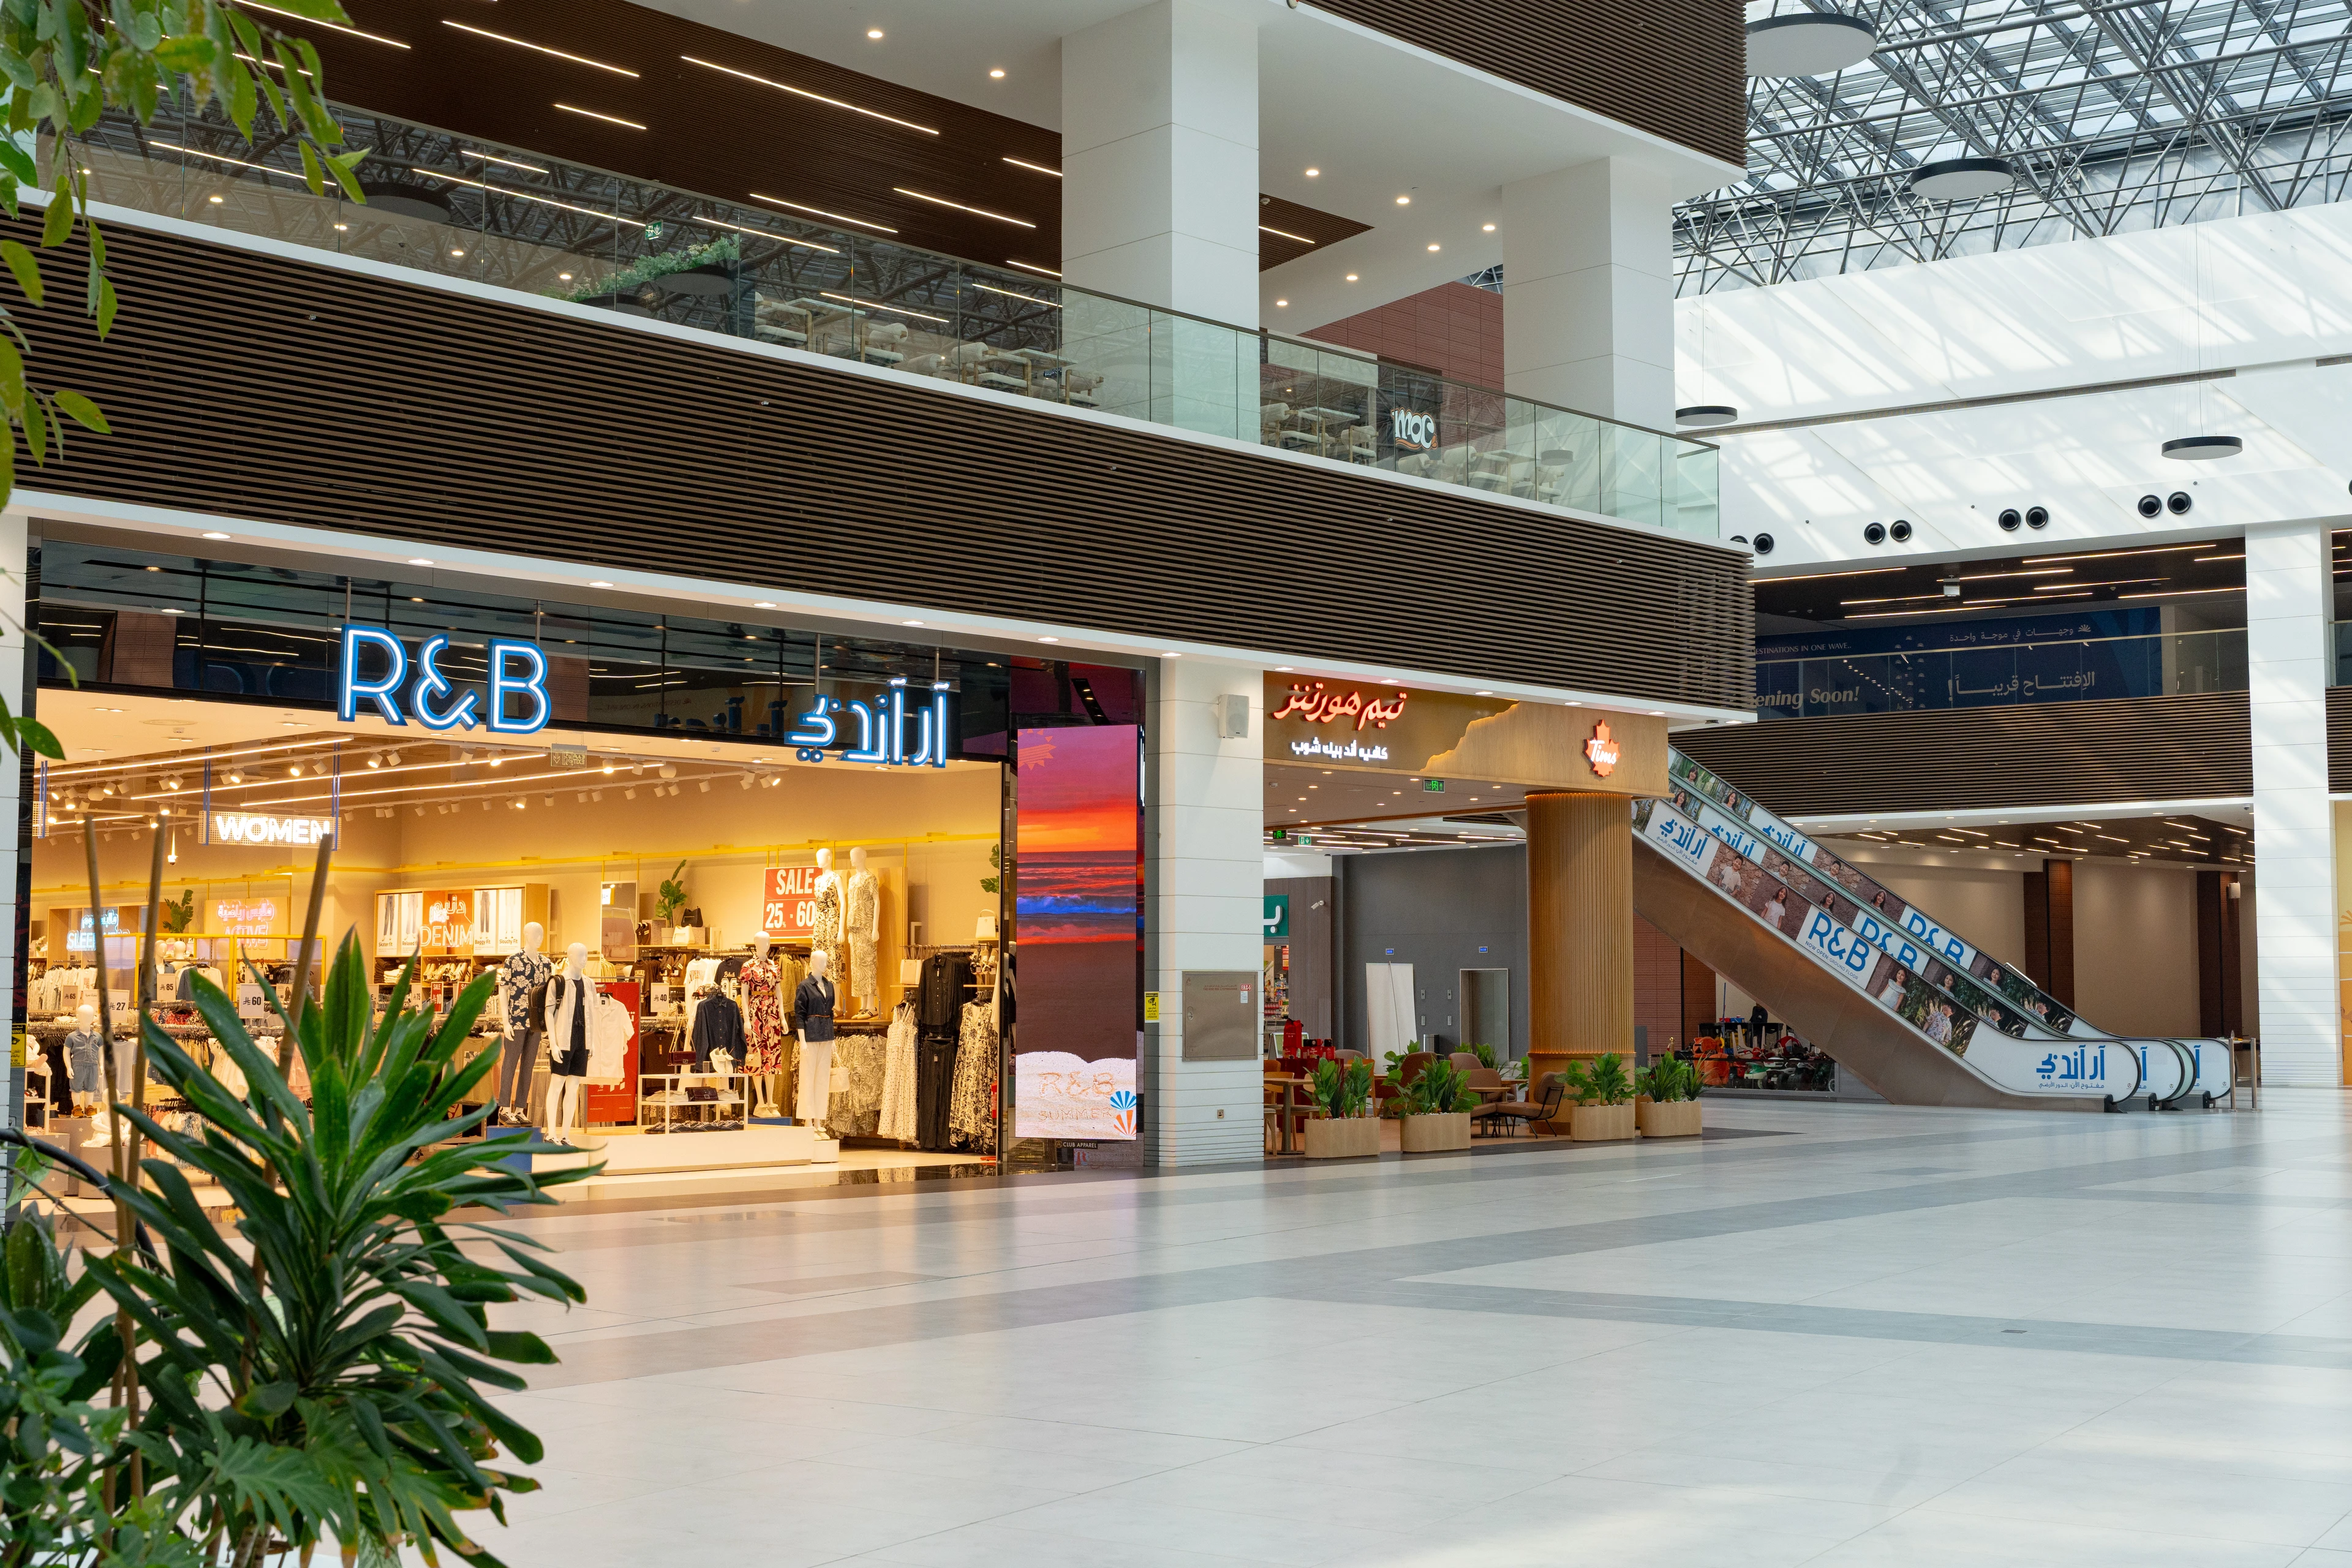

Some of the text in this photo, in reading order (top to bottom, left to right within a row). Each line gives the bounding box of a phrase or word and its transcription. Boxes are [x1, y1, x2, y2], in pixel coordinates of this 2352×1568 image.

[1950, 633, 1976, 643] واحدة
[1981, 631, 2008, 641] موجة
[2013, 628, 2021, 642] في
[337, 624, 551, 734] R&B
[1273, 682, 1408, 731] تيم هورتنز
[1754, 686, 1860, 709] ening Soon!
[1292, 737, 1321, 755] شوب
[1589, 740, 1617, 764] Tims
[216, 816, 330, 843] WOMEN
[776, 869, 814, 895] SALE
[225, 925, 267, 944] ACTIVE
[420, 924, 473, 947] DENIM
[1808, 911, 1869, 971] R&B
[1805, 941, 1830, 960] NOW OPEN:
[1829, 958, 1858, 980] GROUND FLOOR
[116, 1002, 126, 1011] 27
[252, 997, 262, 1006] 60
[1039, 1071, 1116, 1098] R&B
[1039, 1108, 1112, 1121] SUMMER
